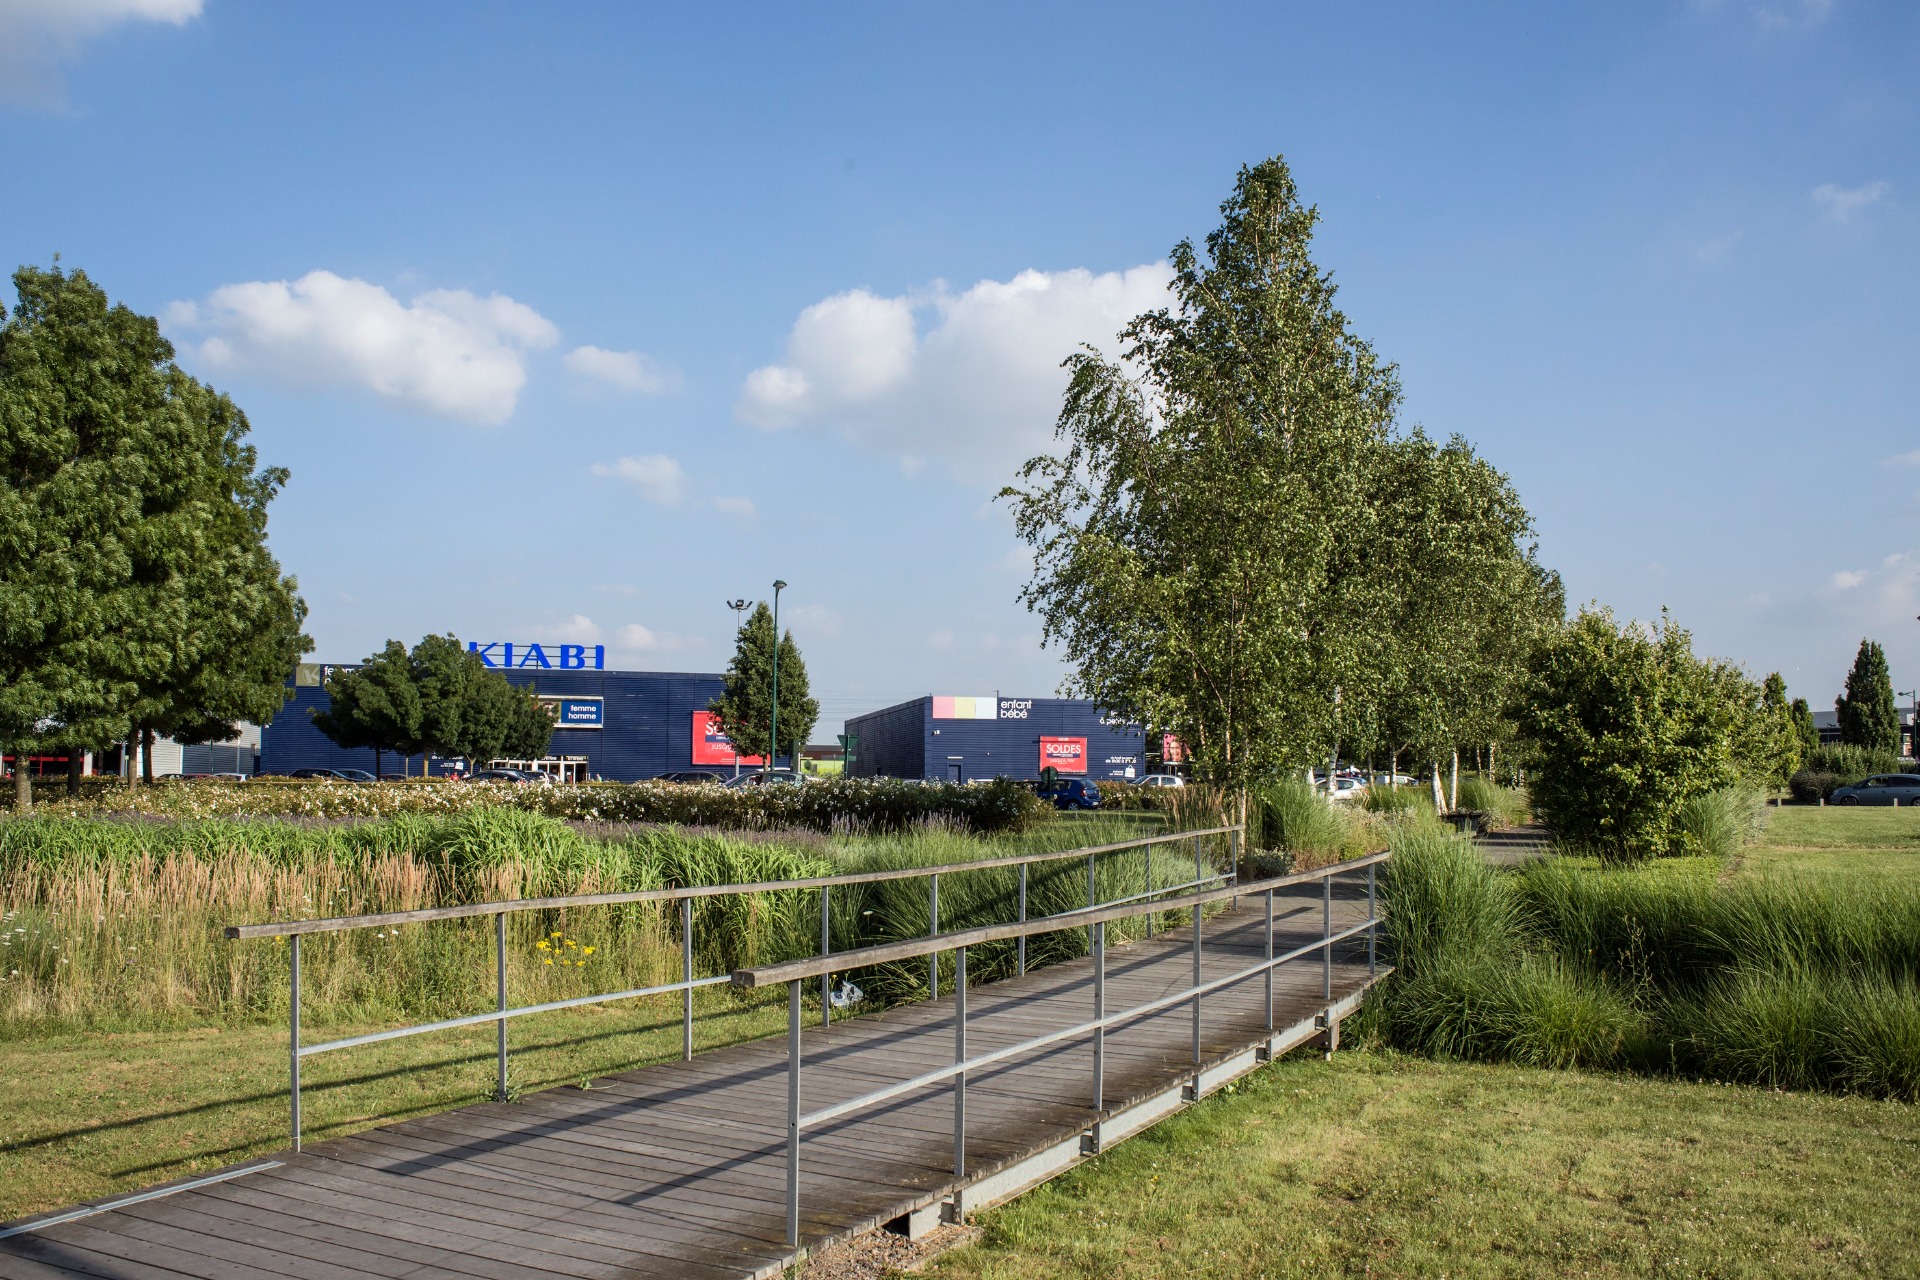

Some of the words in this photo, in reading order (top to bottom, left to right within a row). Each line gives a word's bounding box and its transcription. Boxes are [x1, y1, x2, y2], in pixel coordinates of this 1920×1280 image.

[469, 642, 605, 670] KIABI
[570, 704, 597, 712] femme
[1001, 699, 1032, 709] enfant
[568, 712, 597, 720] homme
[1001, 708, 1028, 719] bébé
[1046, 744, 1081, 754] SOLDES
